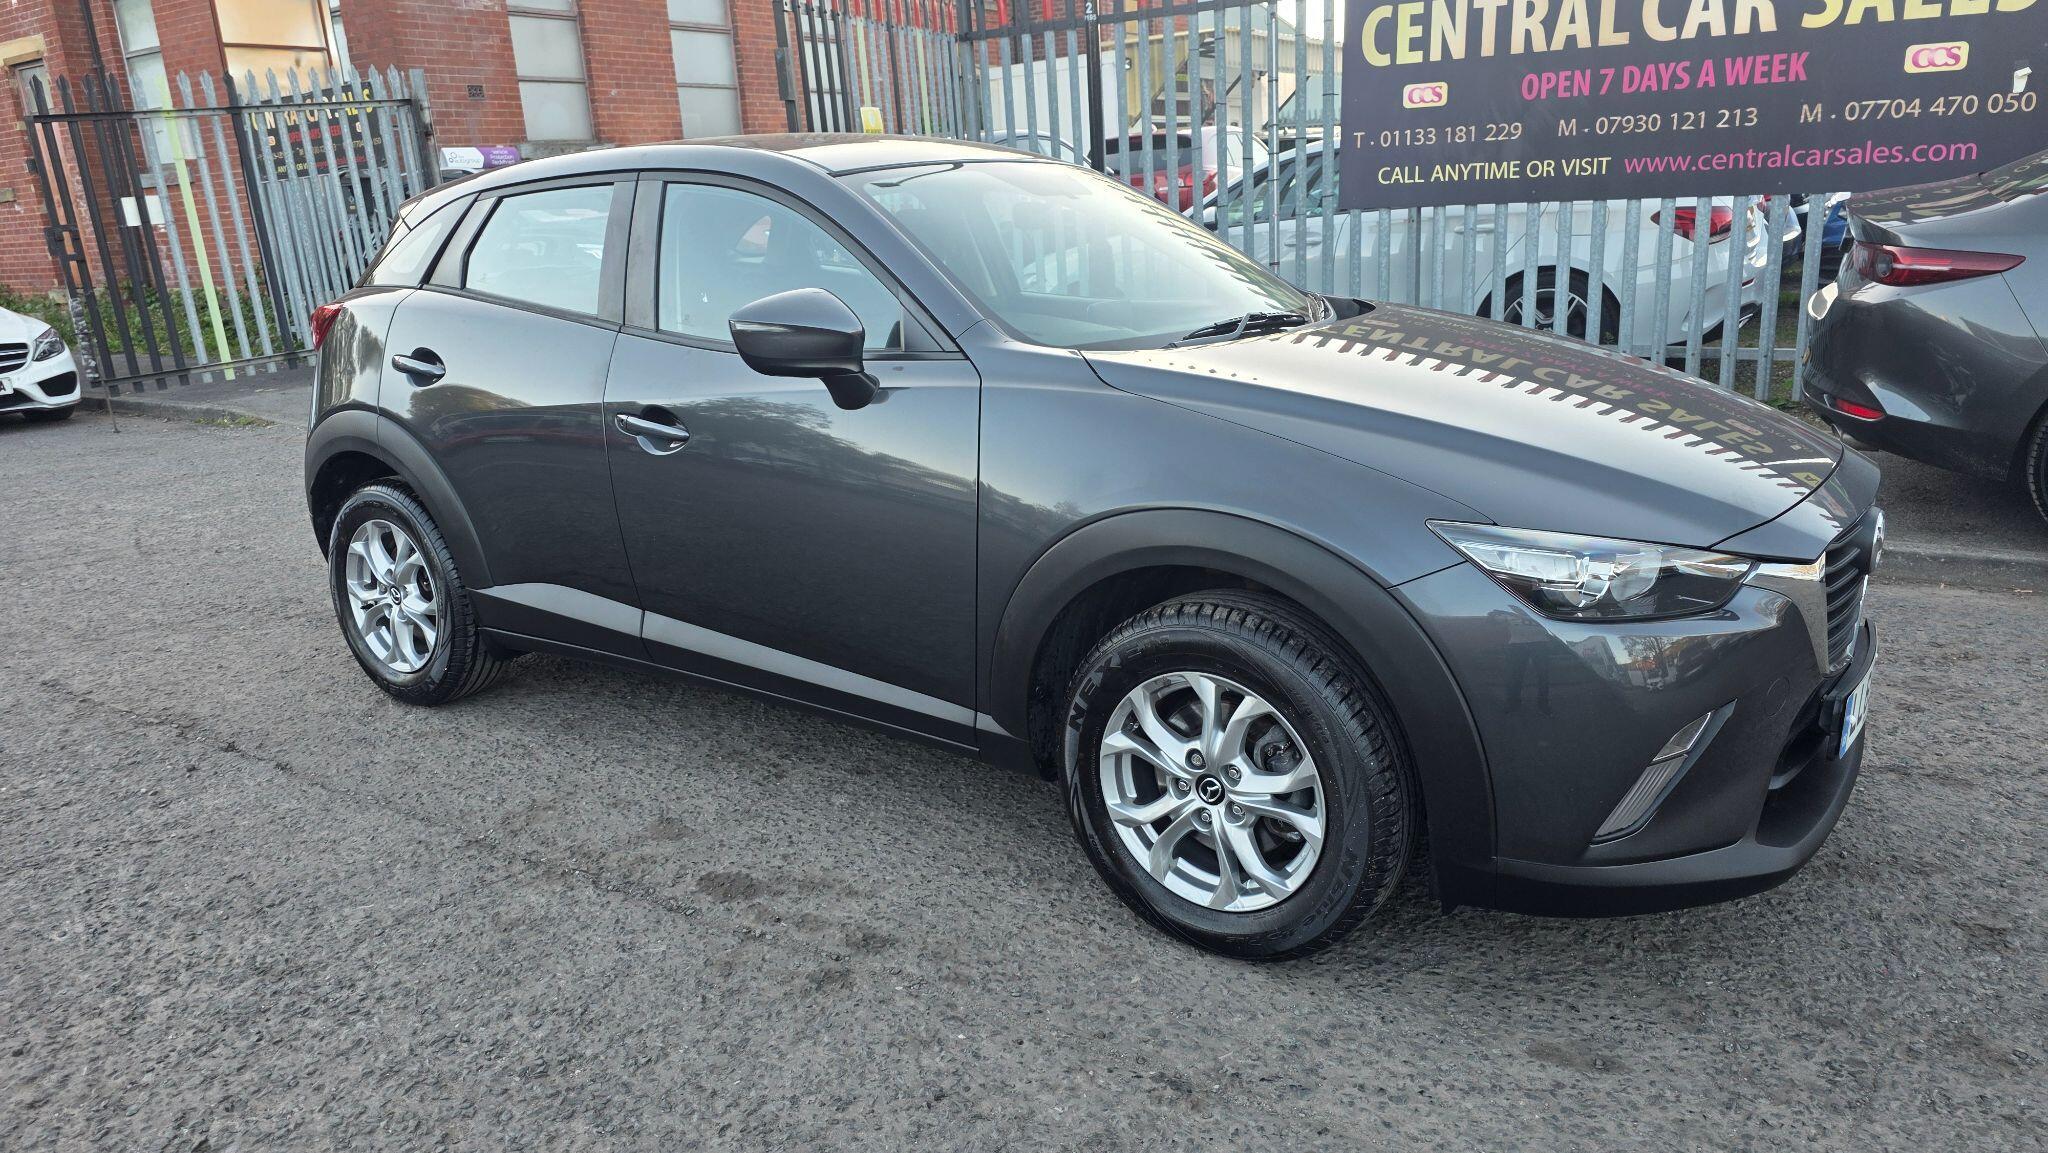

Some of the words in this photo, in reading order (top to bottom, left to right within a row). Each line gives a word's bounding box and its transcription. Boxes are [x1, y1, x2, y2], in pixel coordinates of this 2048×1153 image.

[1362, 0, 1629, 67] CENTRAL
[1521, 69, 1591, 101] OPEN
[1600, 68, 1616, 95] 7
[1623, 61, 1690, 94] DAYS
[1697, 59, 1715, 88] A
[1725, 52, 1808, 86] WEEK
[1596, 113, 1661, 135] 07930
[1671, 112, 1704, 130] 121
[1717, 108, 1758, 128] 213
[1845, 99, 1922, 121] 07704
[1930, 95, 1979, 116] 470
[1988, 91, 2037, 114] 050
[1381, 127, 1436, 147] 01133
[1445, 126, 1475, 143] 181
[1485, 122, 1523, 141] 229
[1378, 165, 1425, 184] CALL
[1431, 161, 1520, 182] ANYTIME
[1527, 160, 1555, 178] OR
[1562, 157, 1612, 176] VISIT
[1625, 141, 1977, 173] www.centralcarsales.com
